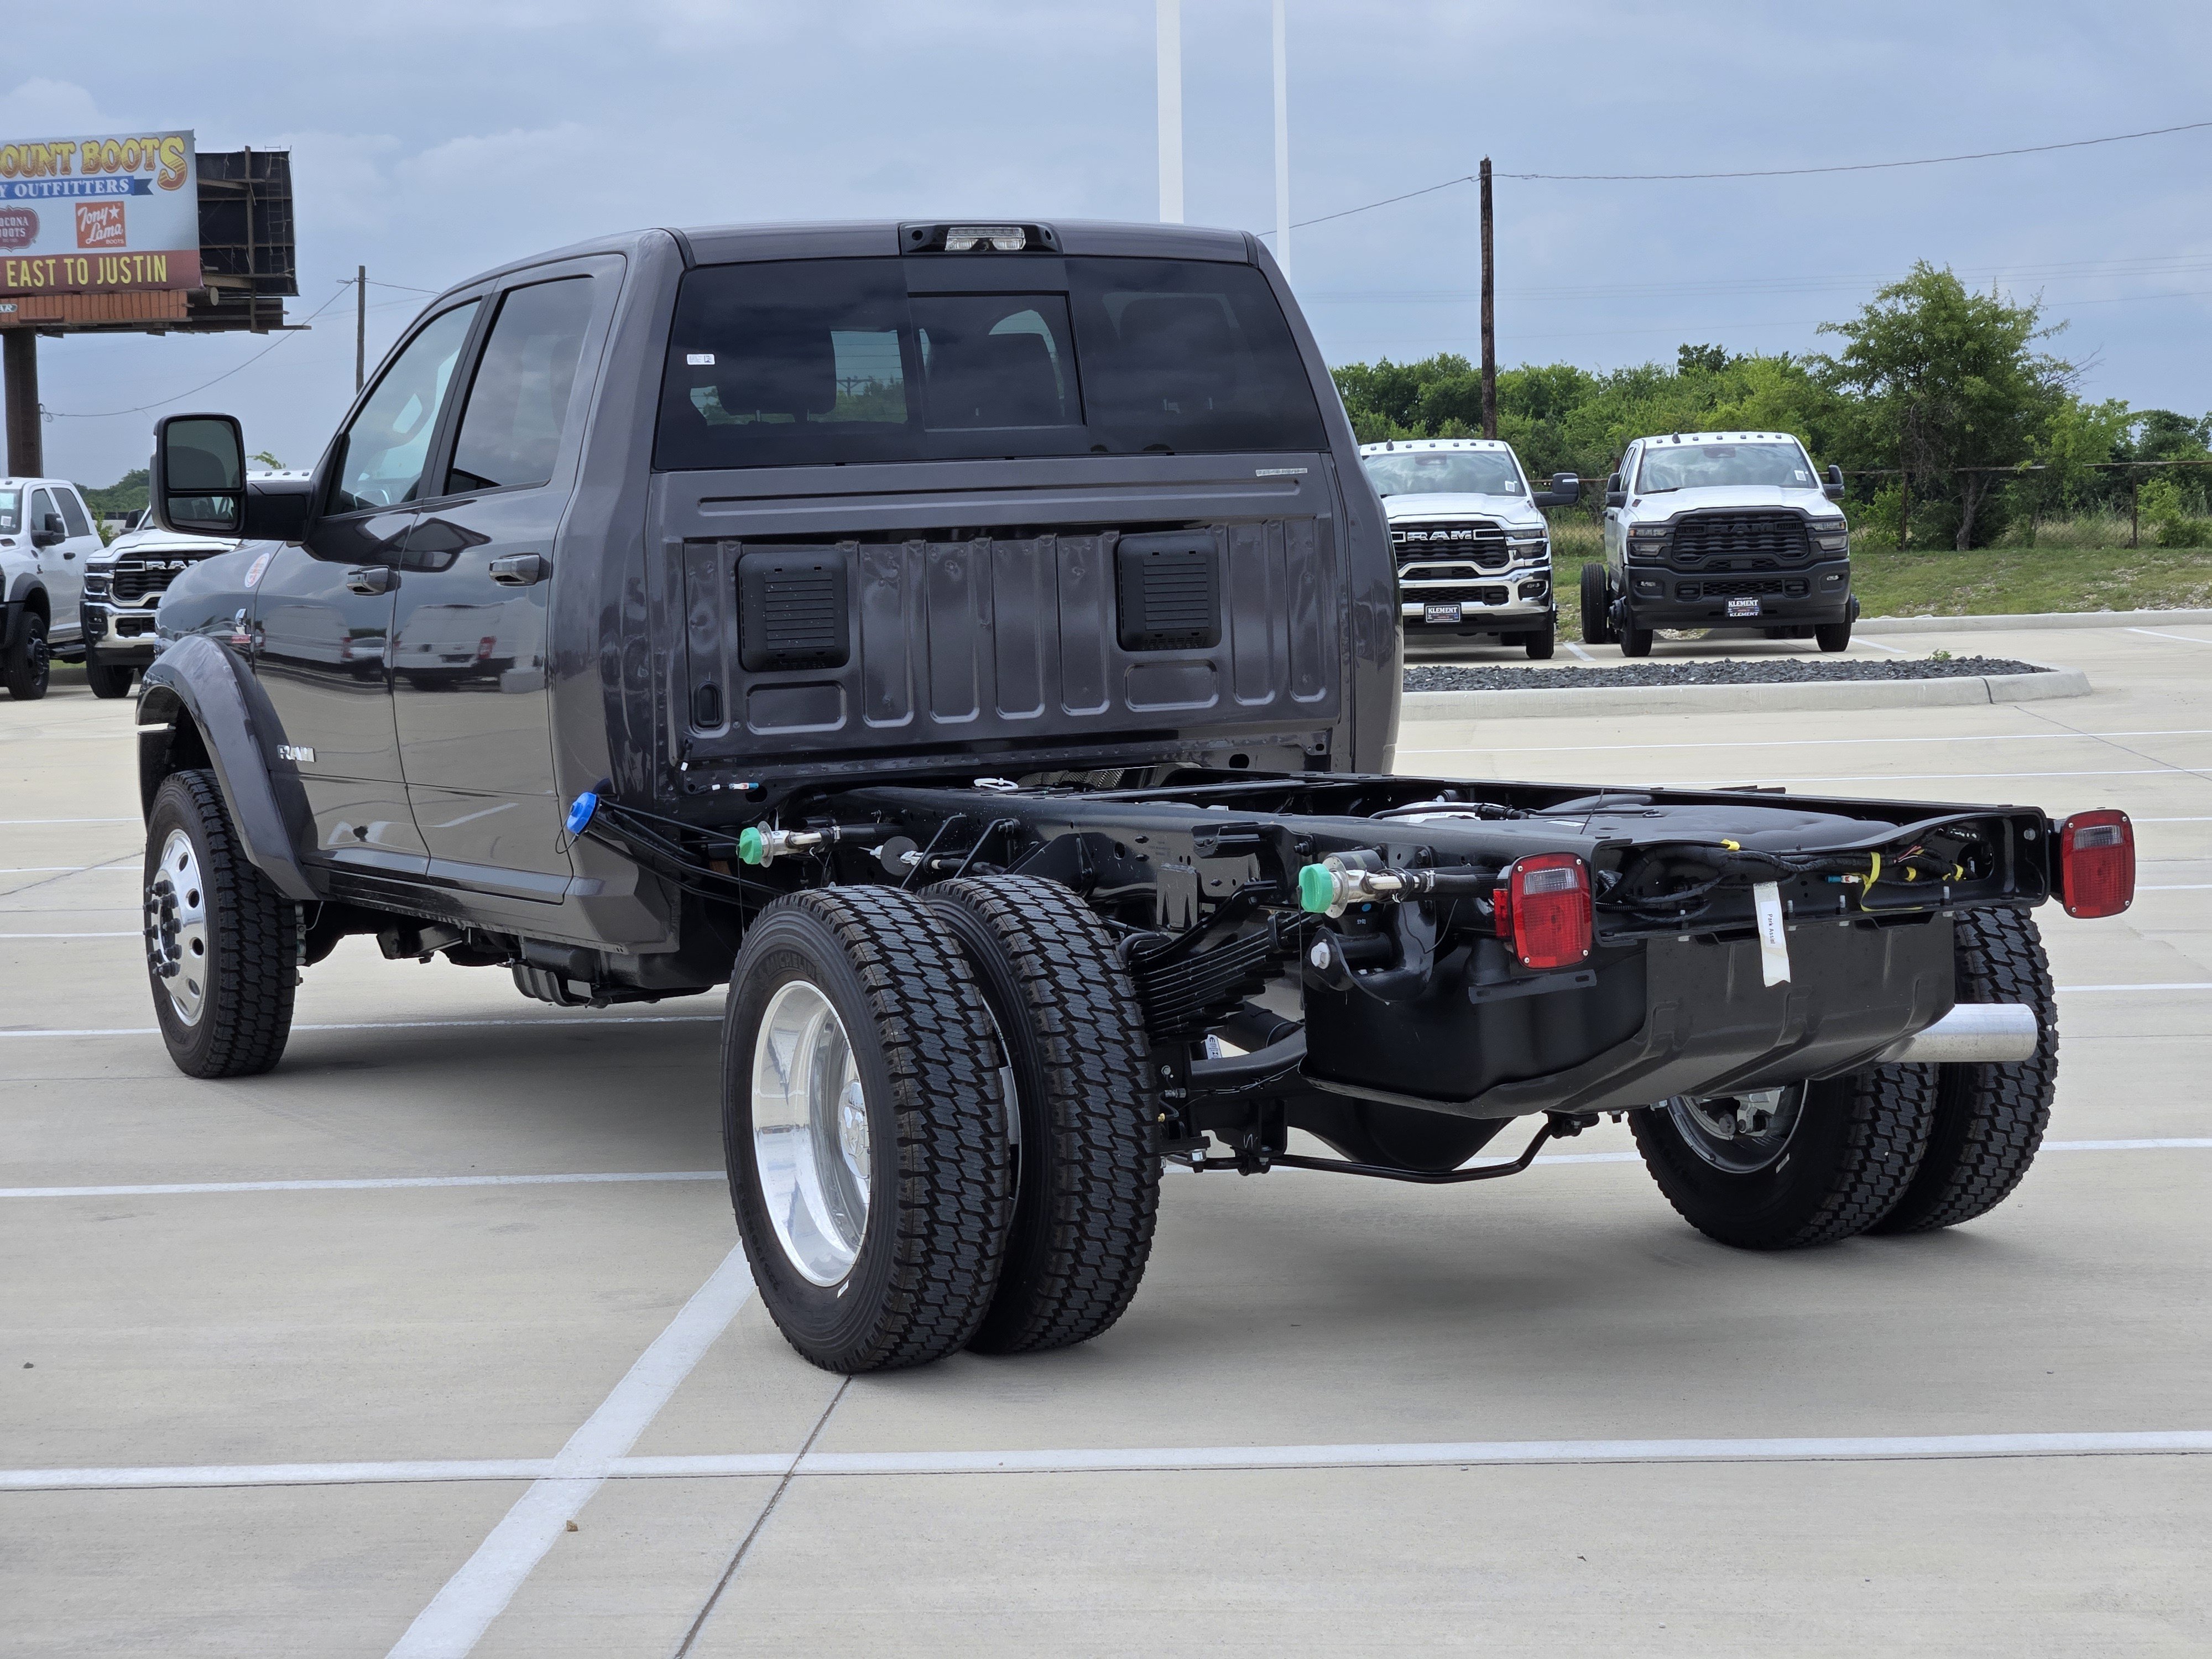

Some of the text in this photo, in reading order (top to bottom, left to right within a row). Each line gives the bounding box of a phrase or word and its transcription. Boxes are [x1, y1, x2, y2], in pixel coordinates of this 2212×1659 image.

[81, 135, 187, 190] BOOTS
[14, 178, 129, 197] OUTFITTERS
[77, 206, 108, 232] Tony
[0, 227, 26, 238] OOTS
[85, 222, 123, 244] Lama
[6, 255, 166, 286] EAST TO JUSTIN
[1407, 531, 1472, 541] RAM
[146, 560, 198, 570] RA
[1728, 599, 1759, 608] KLEMENT
[277, 744, 315, 762] RAM
